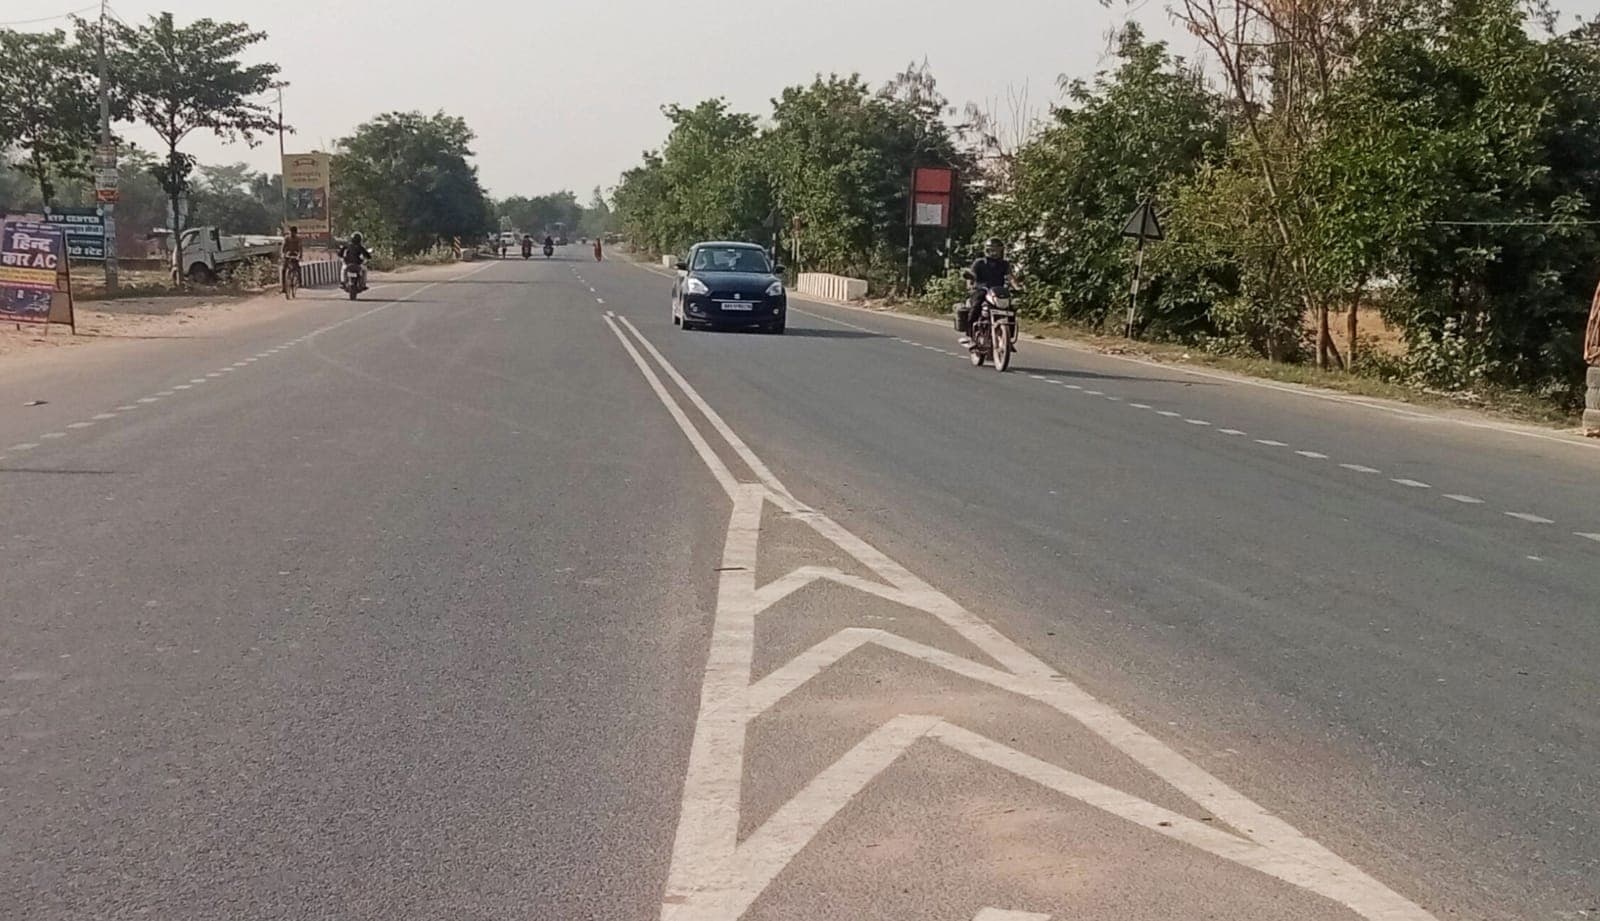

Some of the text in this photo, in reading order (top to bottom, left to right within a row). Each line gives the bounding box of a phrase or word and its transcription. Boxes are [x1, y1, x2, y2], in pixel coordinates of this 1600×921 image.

[66, 215, 99, 223] CENTER
[12, 232, 53, 252] हिन्द
[2, 252, 57, 268] कार AC
